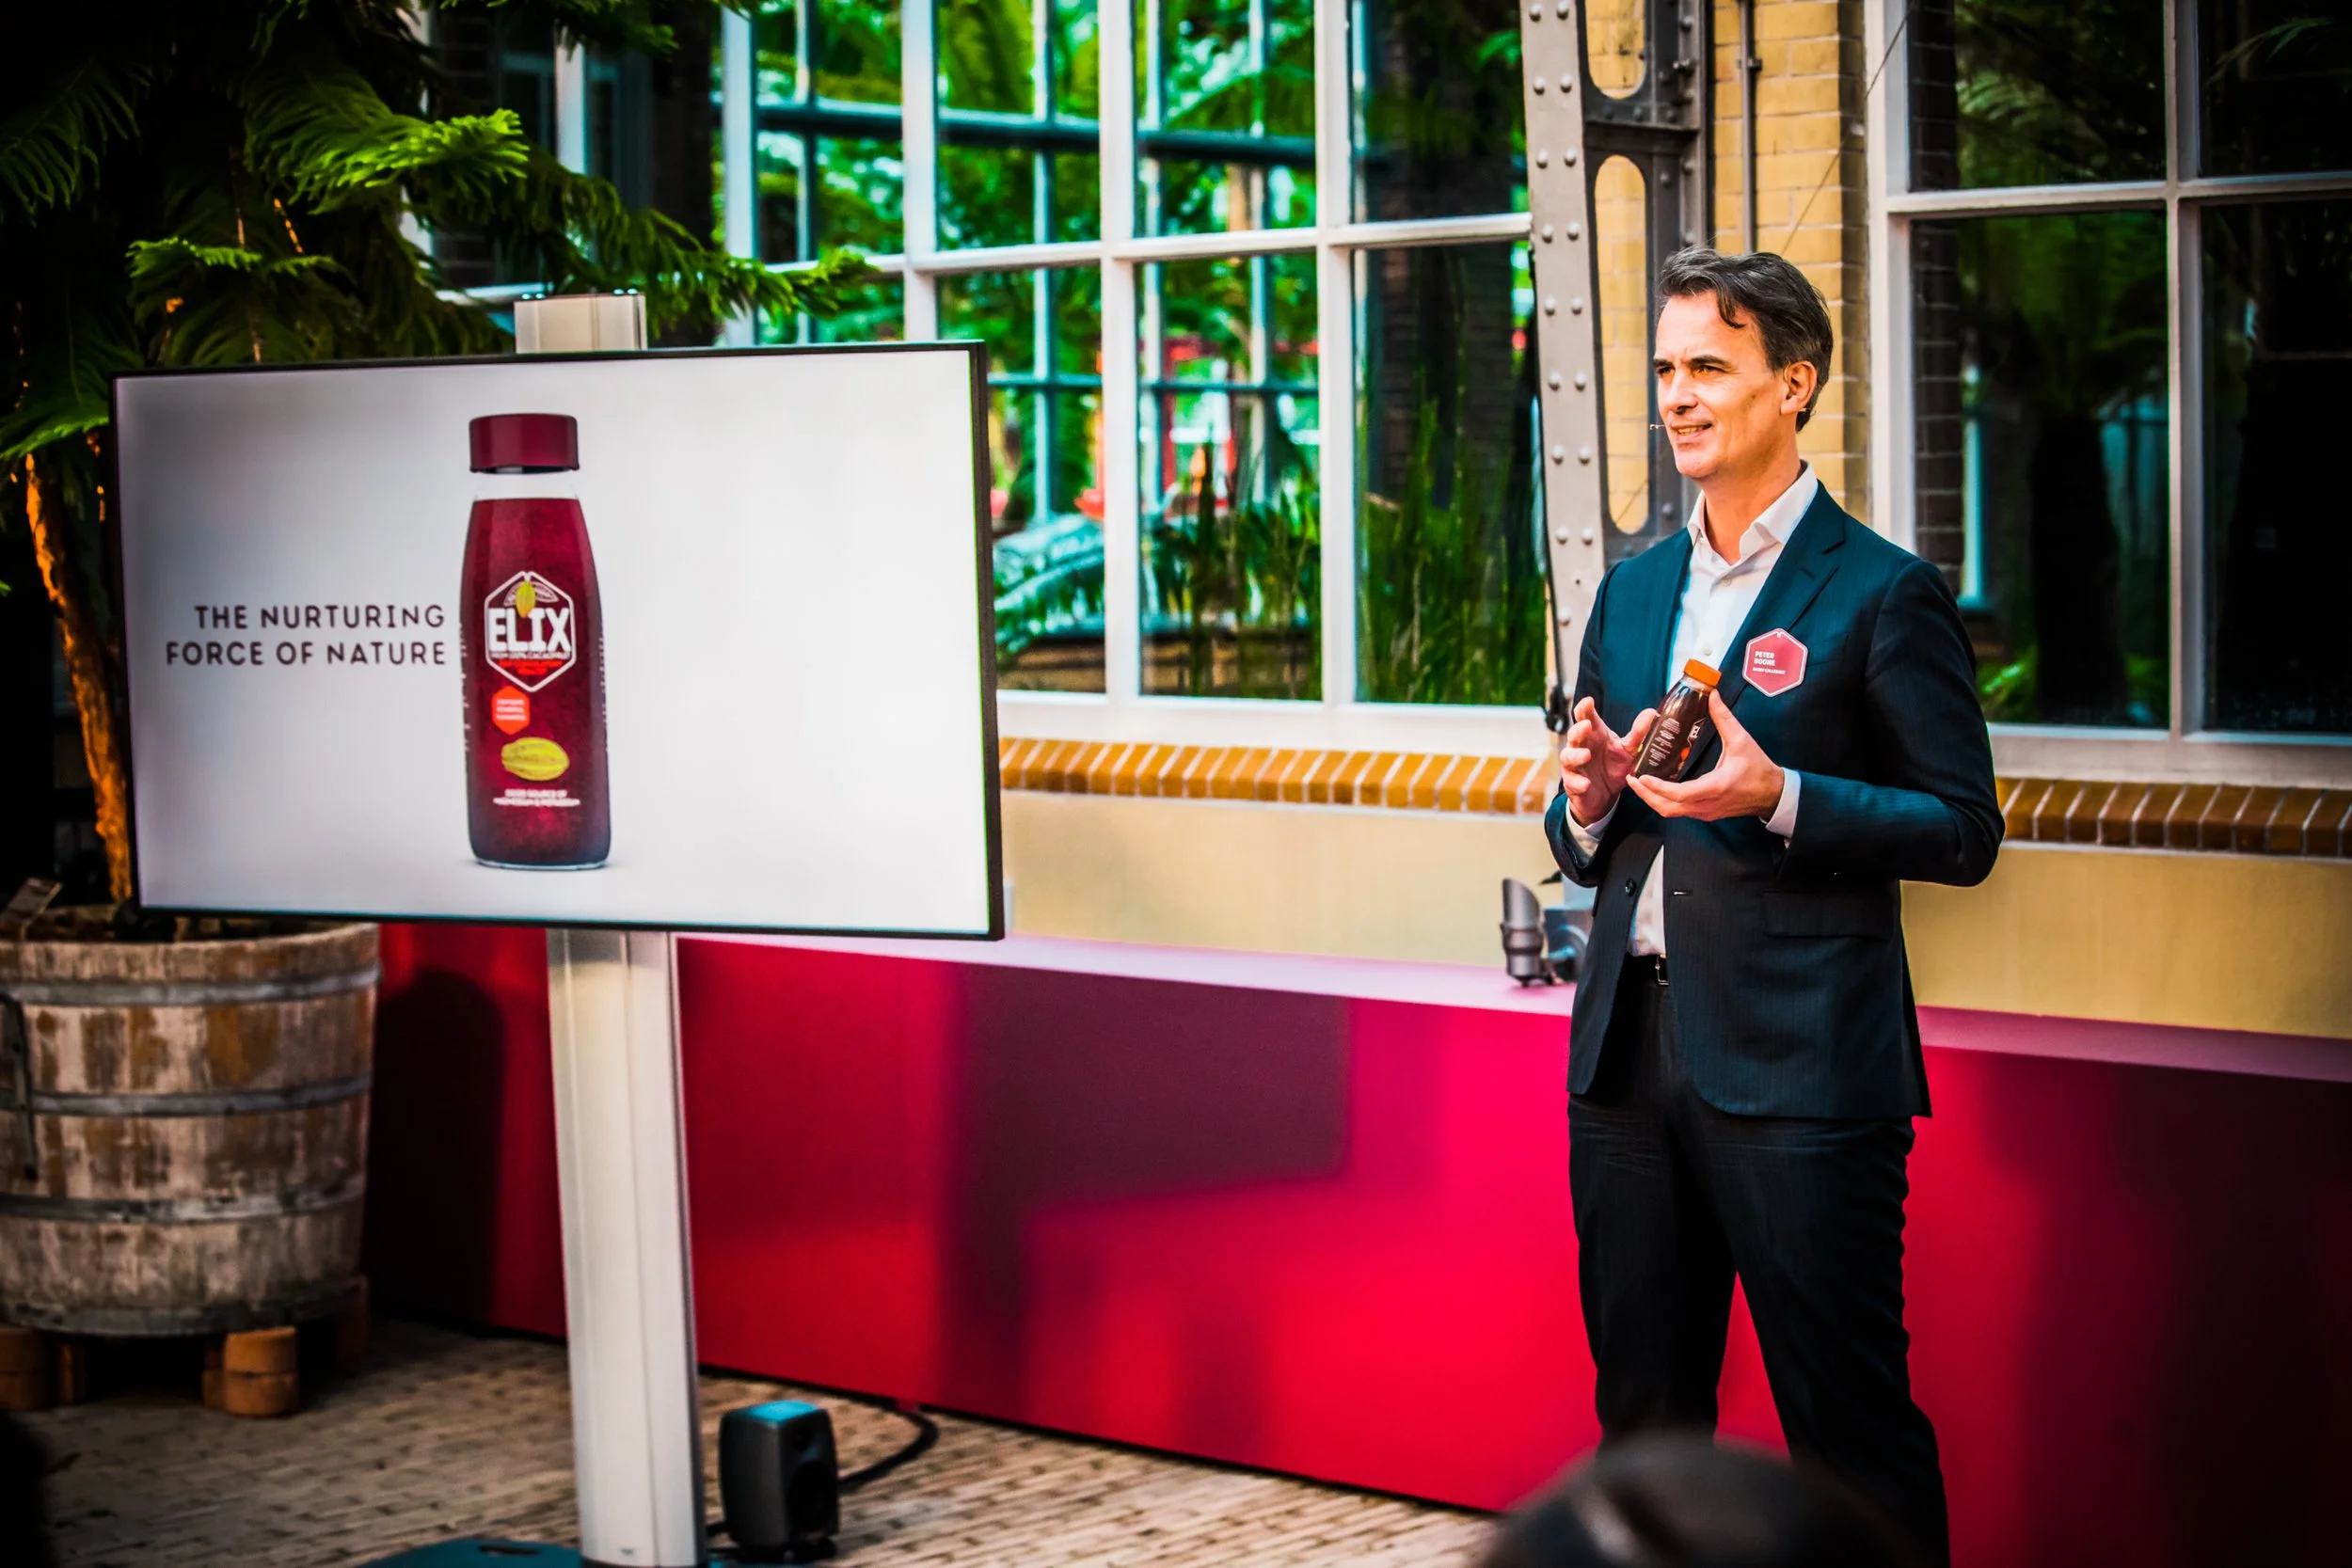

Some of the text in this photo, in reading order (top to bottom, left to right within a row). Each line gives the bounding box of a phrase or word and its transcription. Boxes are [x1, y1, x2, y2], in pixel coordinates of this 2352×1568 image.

[195, 605, 444, 629] THE NURTURING
[487, 608, 572, 652] ELIX
[166, 641, 446, 666] FORCE OF NATURE
[1755, 651, 1775, 659] PETER
